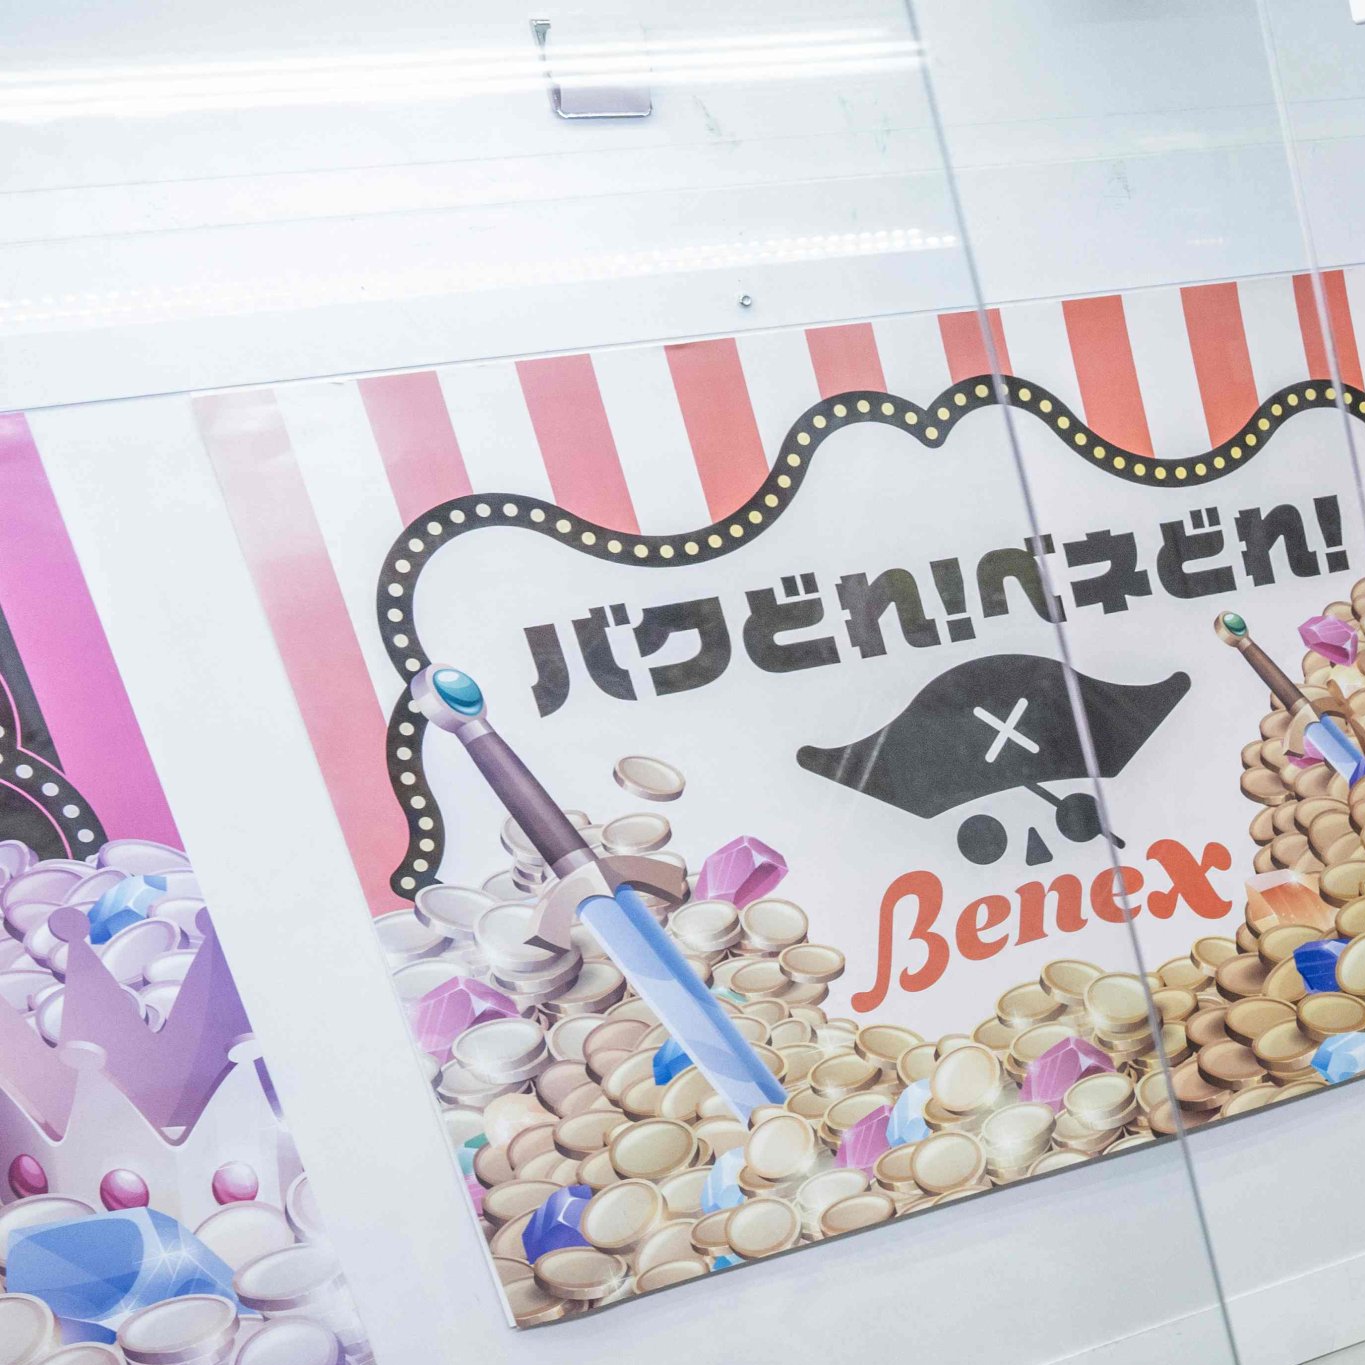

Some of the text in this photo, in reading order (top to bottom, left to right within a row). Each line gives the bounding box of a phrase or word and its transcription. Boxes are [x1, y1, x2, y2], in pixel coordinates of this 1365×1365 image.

[522, 494, 1353, 719] バクどれ!ベネどれ!
[850, 838, 1233, 1014] Benex
